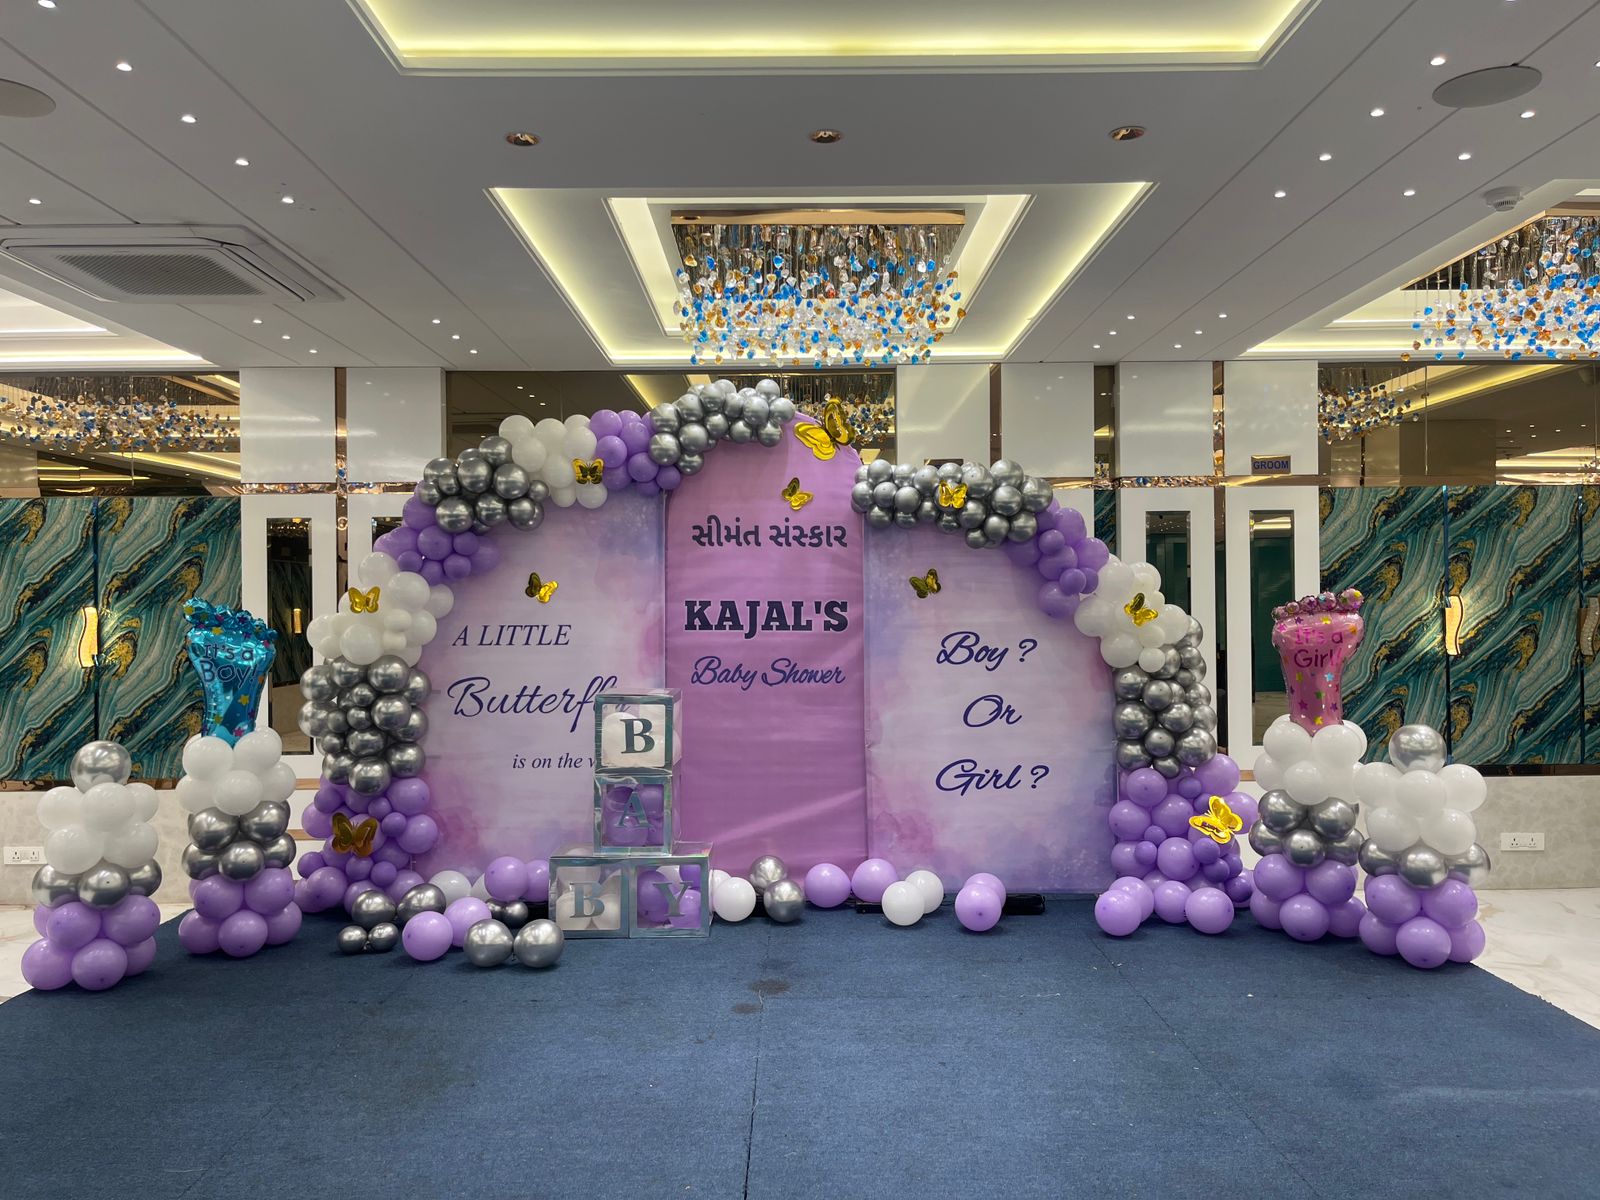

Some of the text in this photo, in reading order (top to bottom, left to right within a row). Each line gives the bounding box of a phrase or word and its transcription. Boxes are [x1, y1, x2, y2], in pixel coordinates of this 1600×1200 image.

[1253, 460, 1289, 470] GROOM
[692, 515, 848, 547] સીમંત સંસ્કાર
[452, 624, 572, 646] A LITTLE
[684, 600, 848, 640] KAJAL'S
[1332, 632, 1343, 644] a
[203, 644, 254, 660] It's a
[936, 631, 1009, 671] Boy
[691, 655, 845, 691] Baby Shower
[447, 675, 630, 733] Butterfl
[963, 694, 1022, 727] Or
[620, 718, 655, 754] B
[512, 754, 525, 769] is
[531, 759, 552, 769] on
[557, 753, 583, 769] the
[935, 758, 1022, 796] Girl
[616, 792, 650, 828] A
[570, 881, 694, 918] B Y
